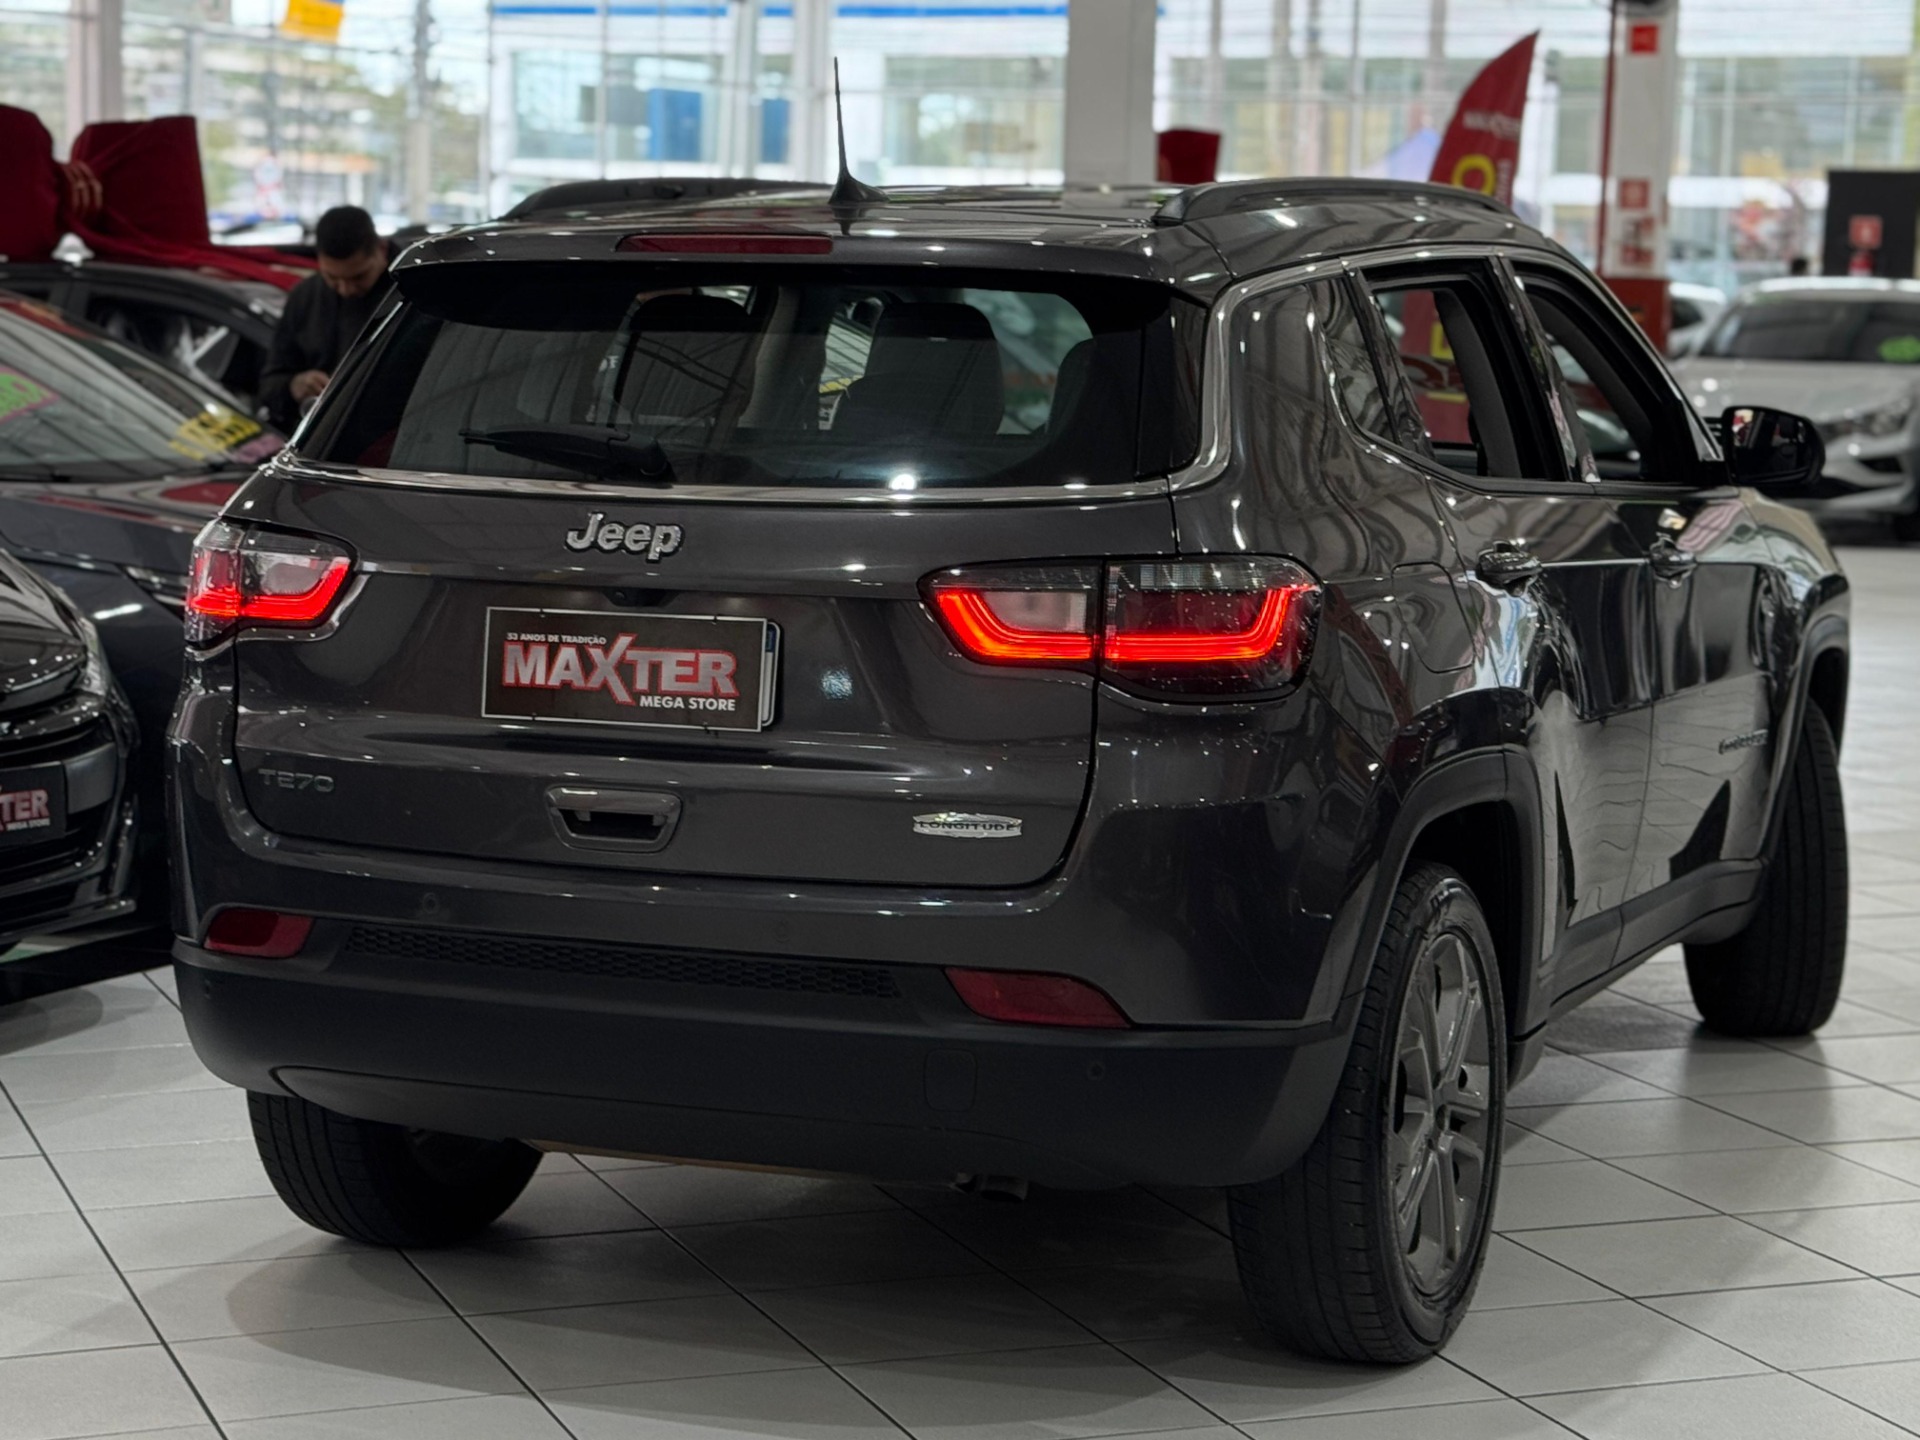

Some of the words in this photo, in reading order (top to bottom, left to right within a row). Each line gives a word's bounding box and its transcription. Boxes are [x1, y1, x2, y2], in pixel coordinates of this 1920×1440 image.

[565, 512, 684, 561] Jeep
[520, 633, 546, 642] ANOS
[547, 634, 560, 643] DE
[561, 633, 607, 646] TRADIÇÃO
[503, 633, 739, 706] MAXTER
[640, 695, 685, 709] MEGA
[688, 697, 736, 712] STORE
[0, 788, 50, 829] TER
[918, 821, 1018, 832] LONGITUDE
